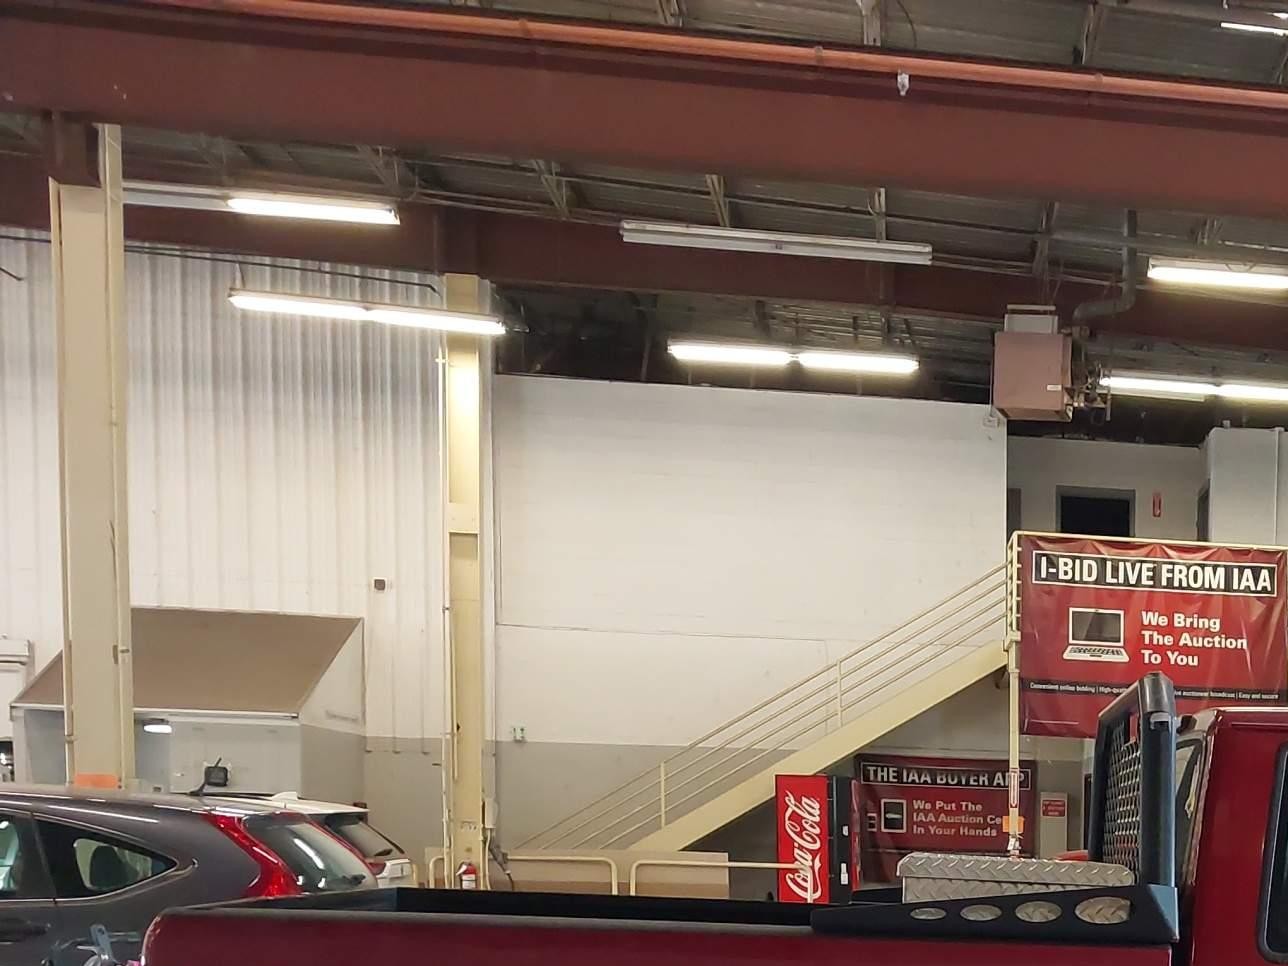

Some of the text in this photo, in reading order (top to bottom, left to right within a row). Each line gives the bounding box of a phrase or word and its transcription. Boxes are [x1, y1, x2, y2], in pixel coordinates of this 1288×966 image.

[1040, 556, 1272, 591] I-BID LIVE FROM IAA
[1141, 611, 1221, 632] We Bring
[1141, 631, 1248, 649] The Auction
[1141, 649, 1199, 667] To You
[866, 766, 898, 782] THE
[902, 768, 932, 784] IAA
[936, 770, 989, 786] BUYER
[913, 800, 983, 812] We Put The
[913, 812, 936, 823] IAA
[938, 814, 984, 825] Auction
[913, 825, 998, 837] In Your Hands
